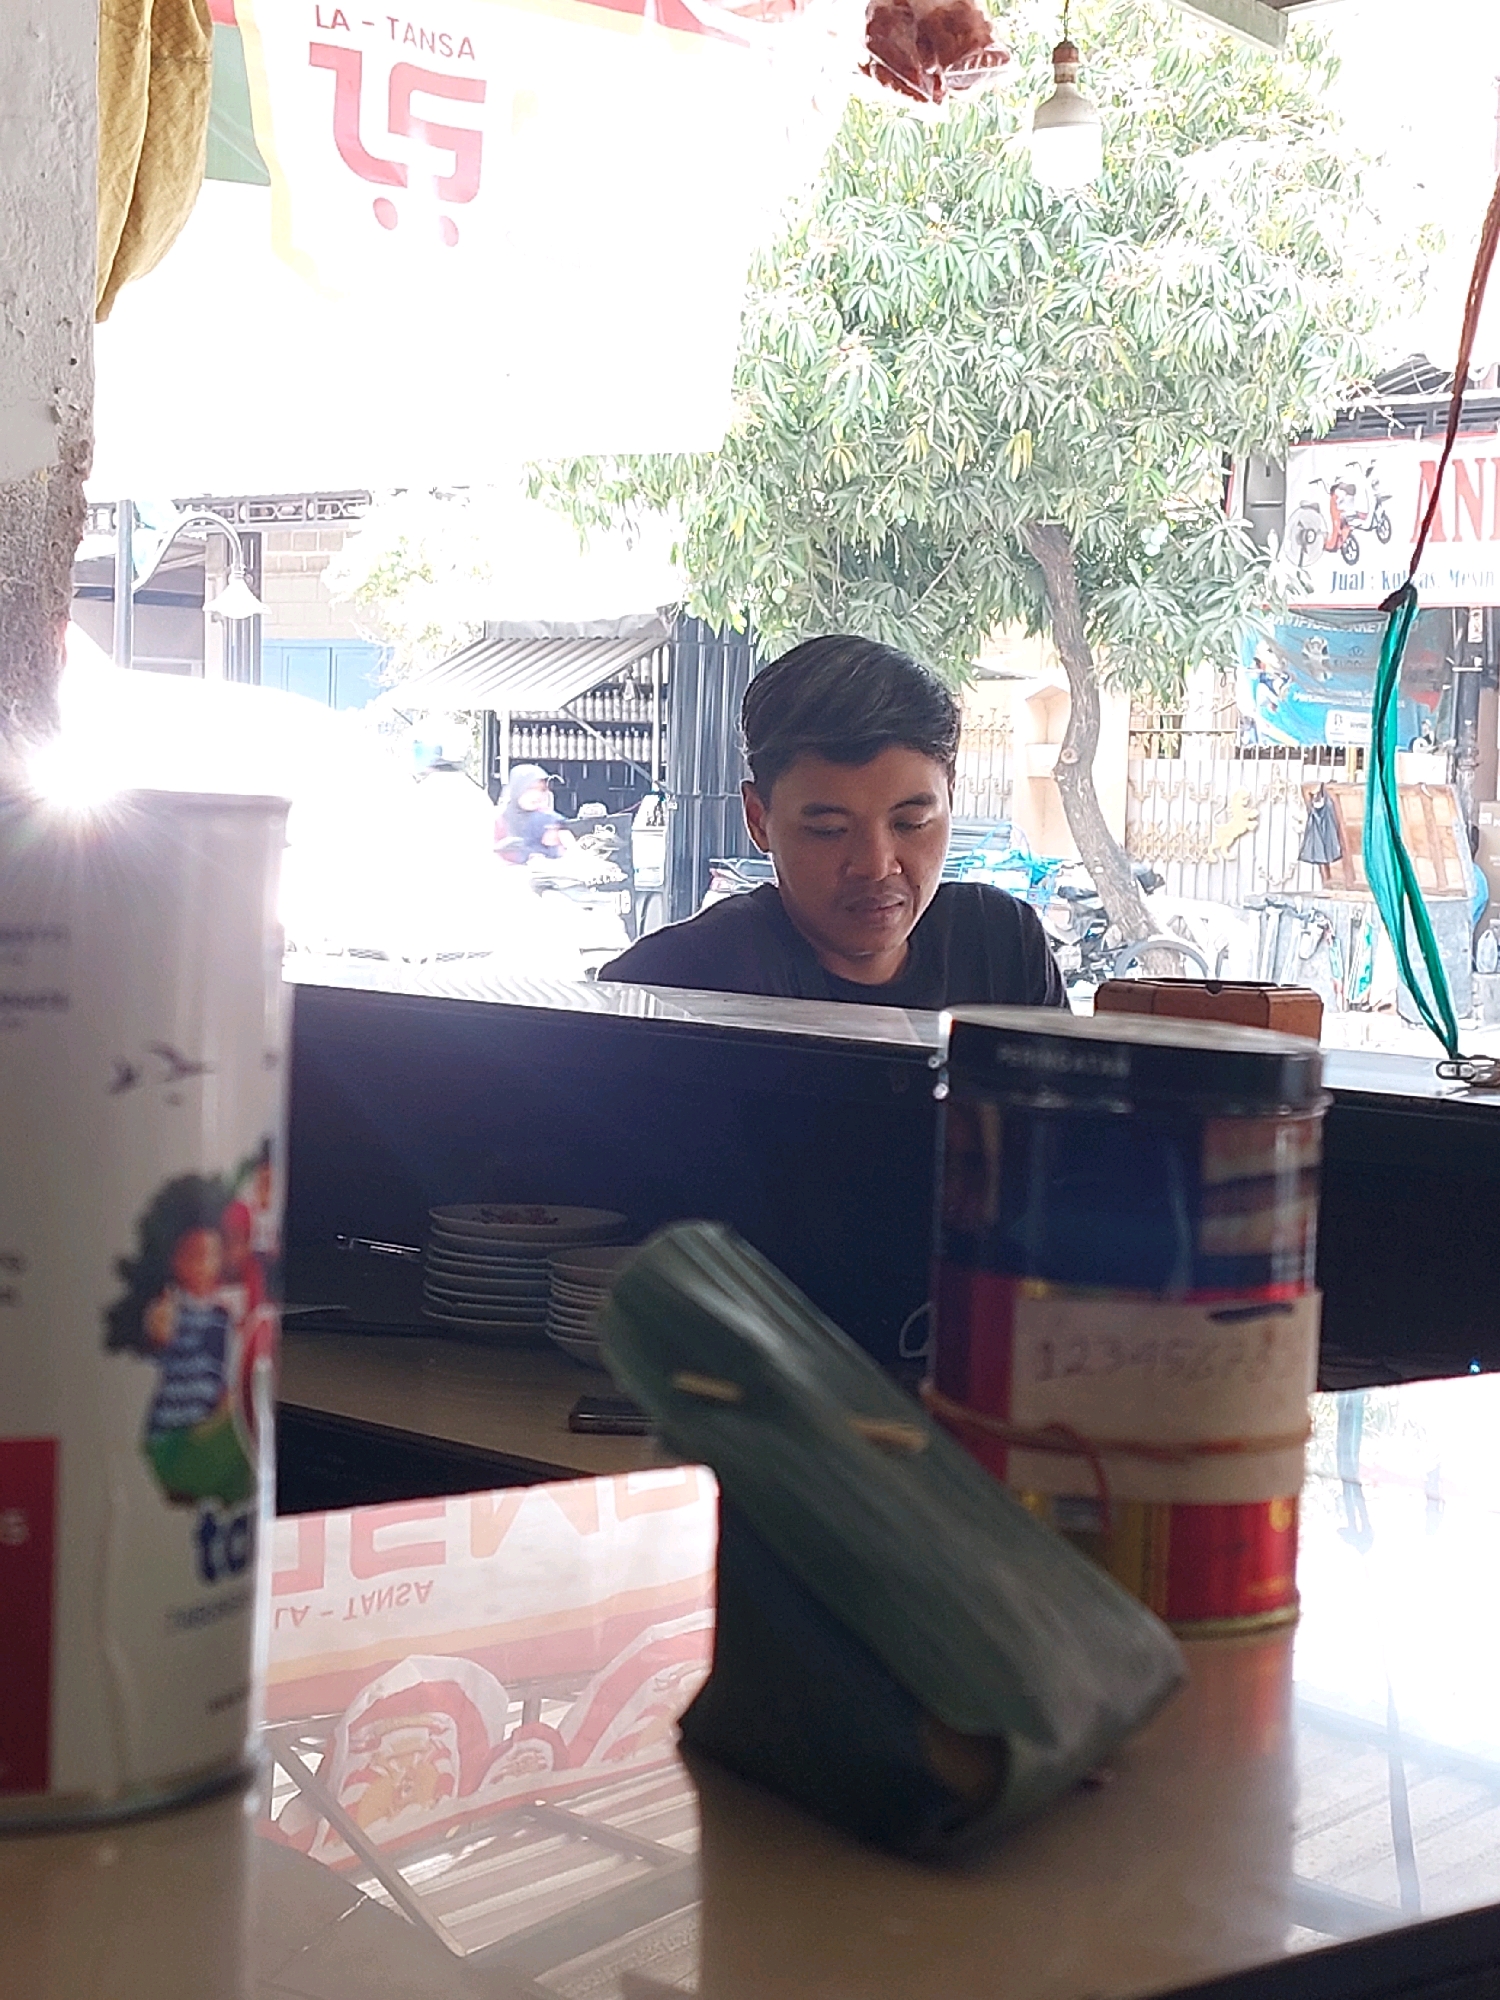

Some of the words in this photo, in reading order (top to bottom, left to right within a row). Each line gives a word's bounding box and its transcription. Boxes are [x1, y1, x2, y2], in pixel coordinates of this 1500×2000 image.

[315, 4, 351, 31] LA
[386, 15, 476, 61] TANSA
[1330, 571, 1365, 593] Jual
[1449, 568, 1494, 588] Mesin
